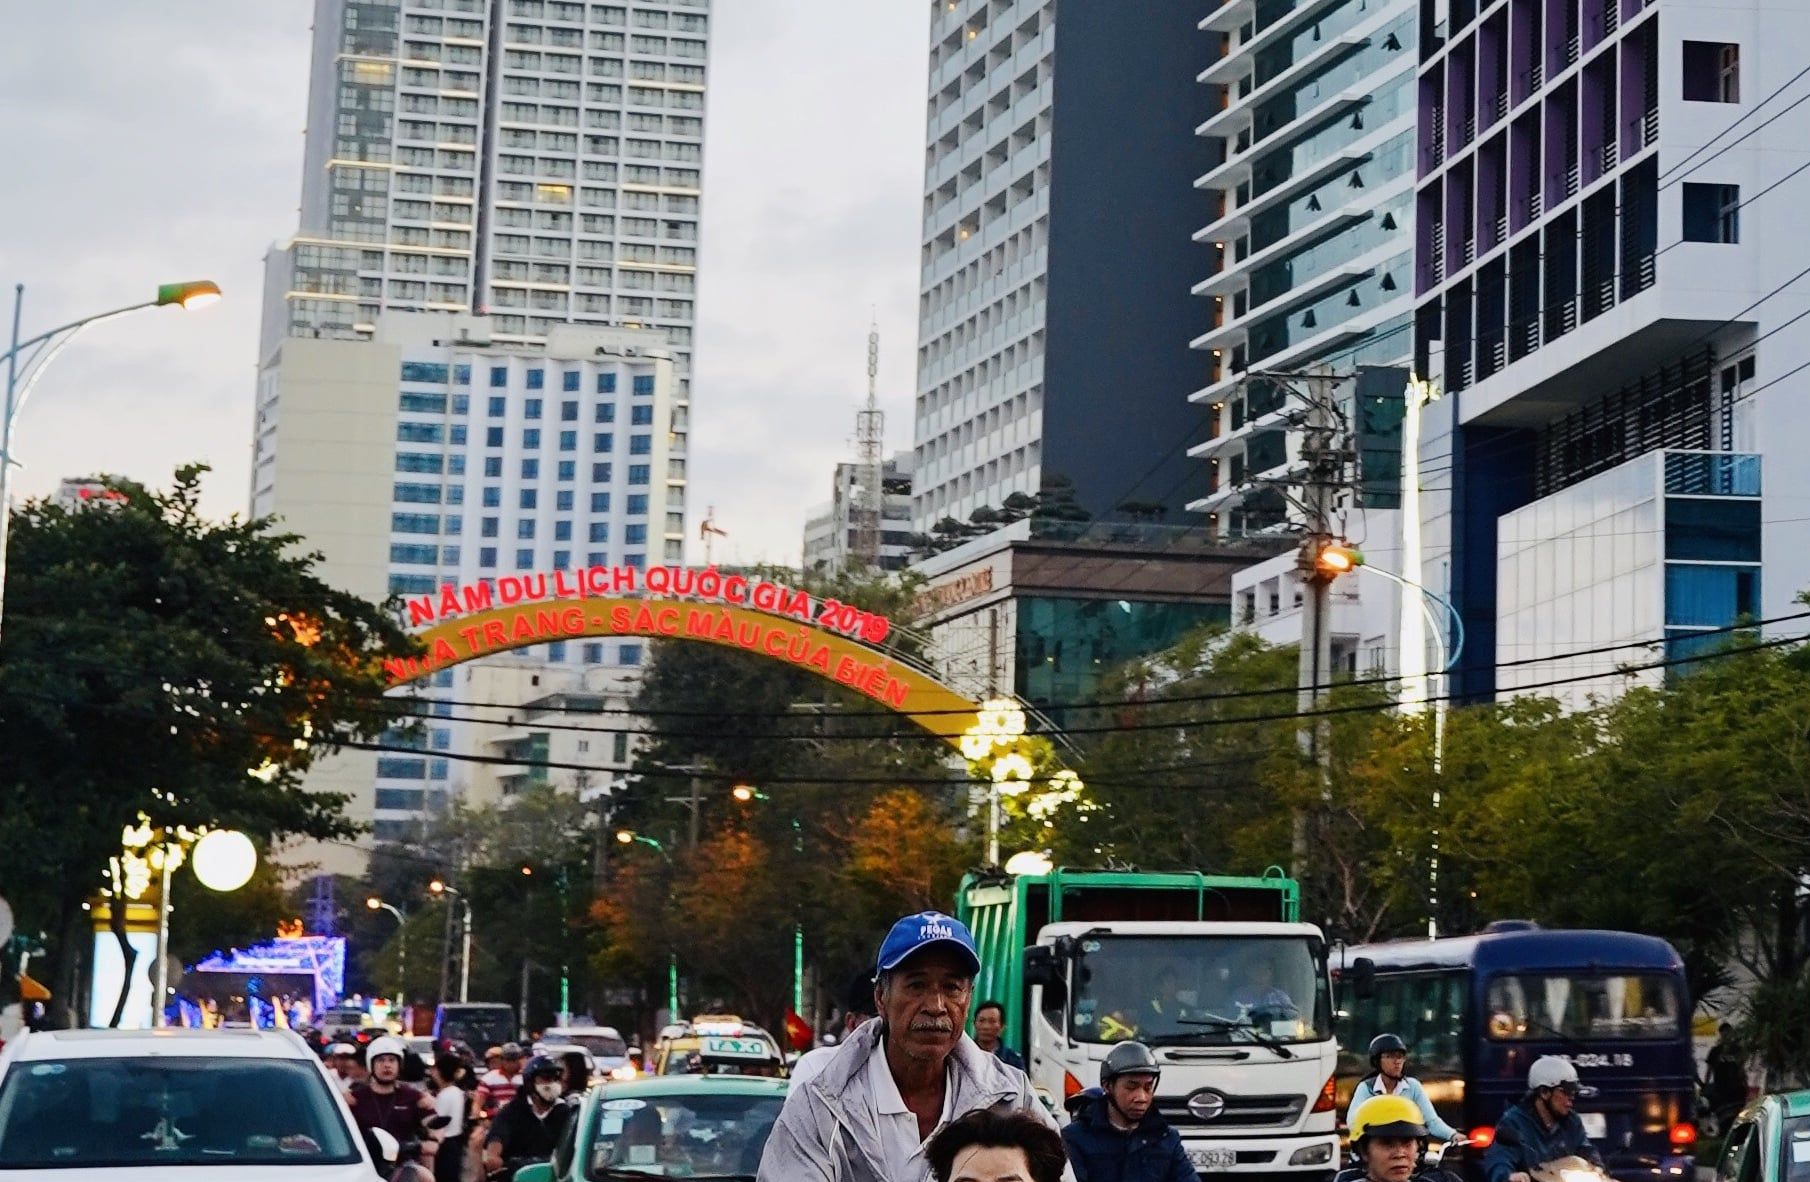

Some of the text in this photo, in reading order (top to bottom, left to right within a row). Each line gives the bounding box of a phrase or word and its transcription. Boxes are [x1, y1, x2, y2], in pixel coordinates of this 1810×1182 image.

[408, 563, 890, 643] NĂM DU LỊCH QUỐC GIA 2019
[458, 606, 585, 653] TRANG
[686, 606, 761, 648] MÀU
[763, 626, 830, 672] CỦA
[710, 1038, 764, 1055] TAXI
